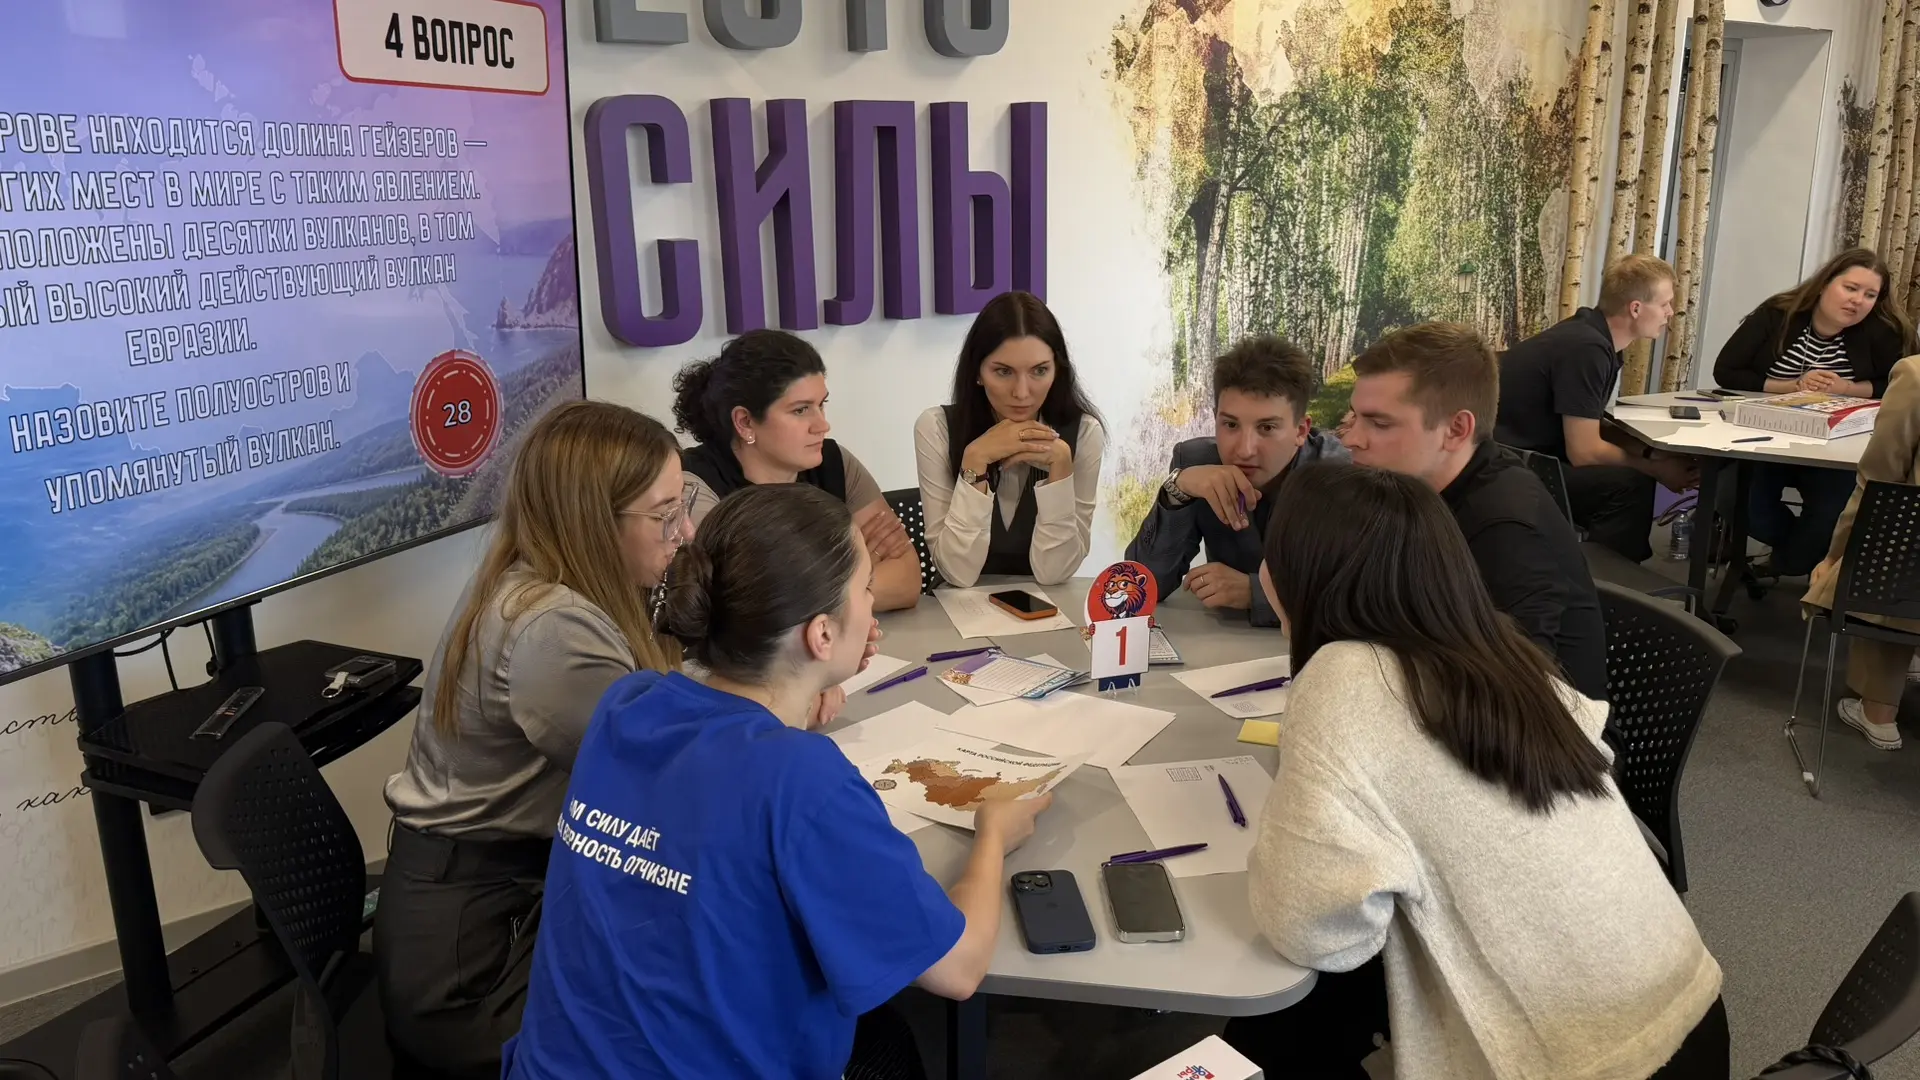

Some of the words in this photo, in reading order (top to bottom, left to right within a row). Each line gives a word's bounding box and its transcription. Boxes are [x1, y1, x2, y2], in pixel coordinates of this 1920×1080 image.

[385, 12, 403, 58] 4
[412, 15, 515, 69] ВОПРОС
[88, 115, 255, 157] НАХОДИТСЯ
[263, 121, 354, 158] ДОЛИНА
[359, 121, 459, 158] ГЕЙЗЕРОВ
[0, 171, 65, 212] ГИХ
[72, 171, 154, 210] МЕСТ
[164, 171, 183, 207] В
[190, 171, 265, 207] МИРЕ
[269, 171, 285, 204] С
[290, 171, 369, 204] ТАКИМ
[373, 171, 481, 202] ЯВЛЕНИЕМ.
[183, 218, 298, 260] ДЕСЯТКИ
[302, 213, 416, 250] ВУЛКАНОВ,
[418, 213, 431, 243] В
[434, 212, 475, 241] ТОМ
[583, 94, 1048, 347] СИЛЫ
[45, 269, 191, 322] ВЫСОКИЙ
[199, 255, 381, 310] ДЕЙСТВУЮЩИЙ
[384, 253, 456, 289] ВУЛКАН
[125, 318, 258, 367] ЕВРАЗИИ.
[9, 391, 170, 453] НАЗОВИТЕ
[175, 366, 332, 423] ПОЛУОСТРОВ
[335, 362, 351, 392] И
[443, 399, 472, 428] 28
[44, 434, 241, 514] УПОМЯНУТЫЙ
[247, 420, 341, 469] ВУЛКАН.
[1115, 626, 1128, 666] 1
[586, 808, 631, 838] СИЛУ
[625, 825, 660, 851] ДАЁТ
[623, 855, 692, 895] ОТЧИЗНЕ
